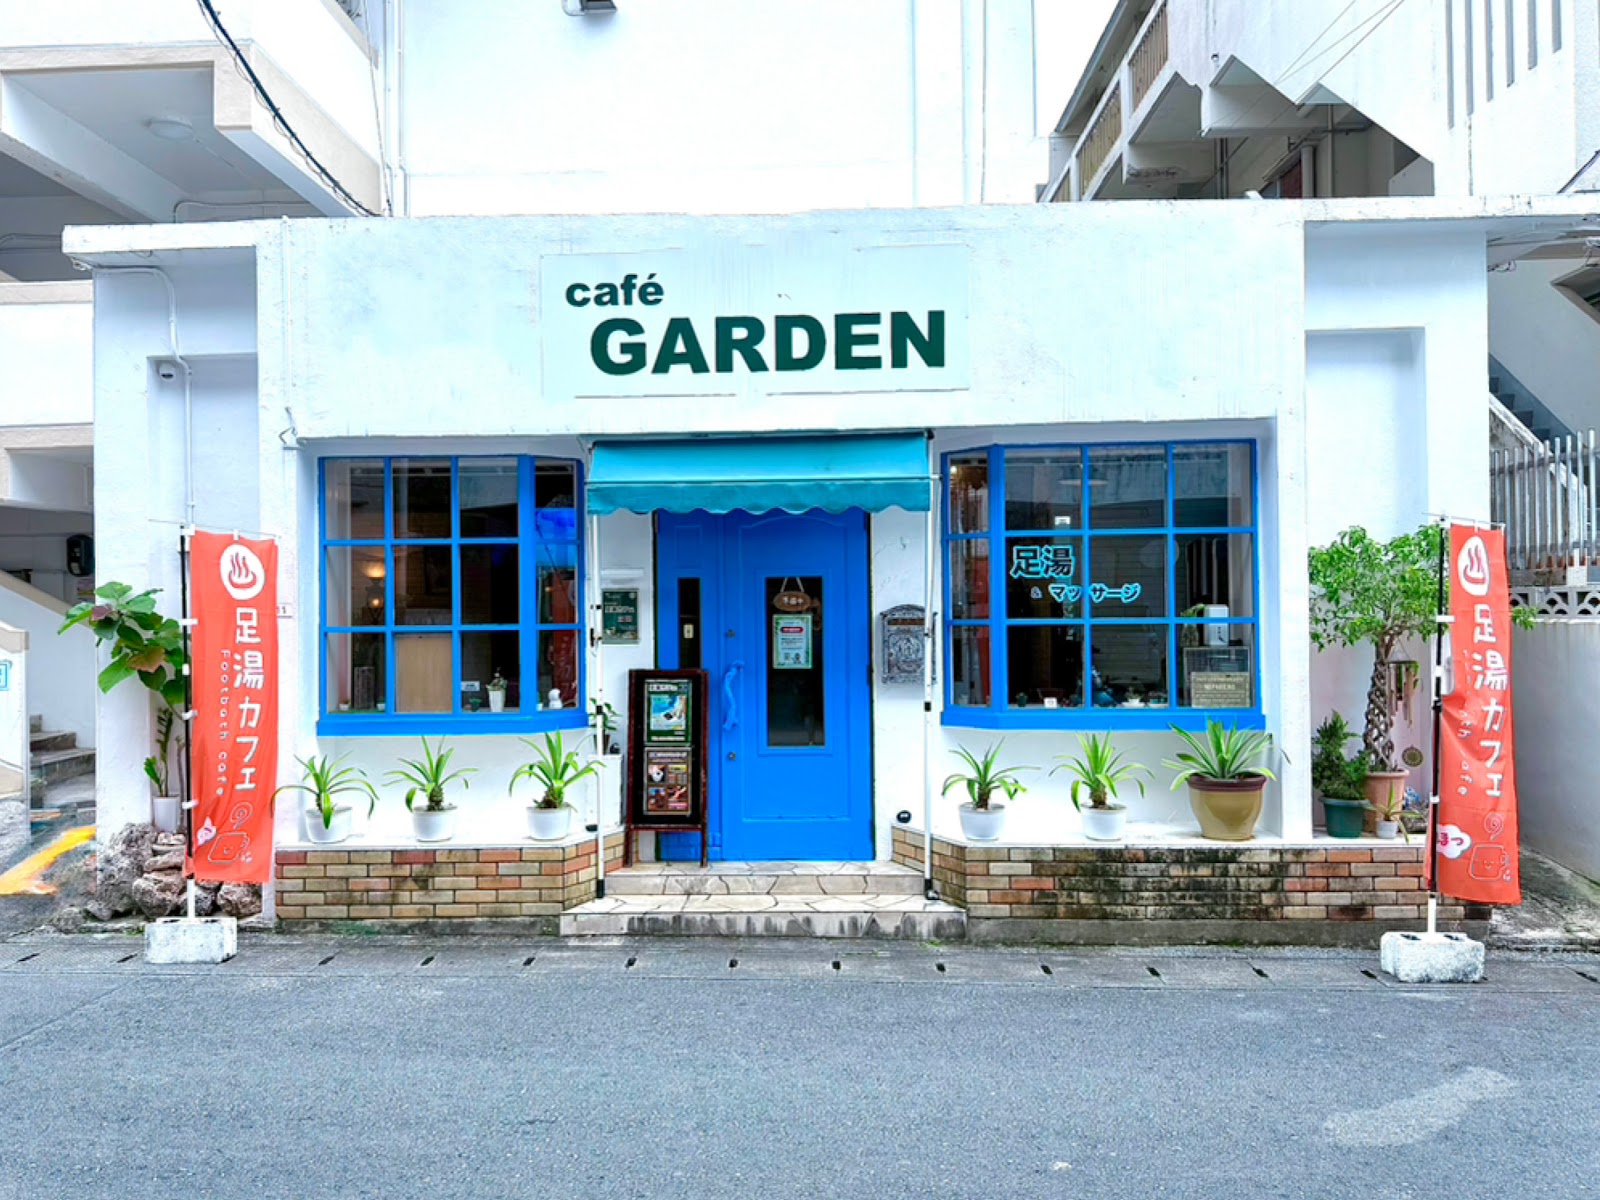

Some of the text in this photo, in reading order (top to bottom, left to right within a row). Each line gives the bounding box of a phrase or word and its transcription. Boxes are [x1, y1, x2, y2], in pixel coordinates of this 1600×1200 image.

[565, 273, 664, 307] café
[590, 310, 945, 375] GARDEN
[1010, 545, 1075, 578] 足湯
[1048, 583, 1142, 603] マッサージ
[232, 607, 265, 792] 足湯カフェ
[1472, 604, 1508, 797] 足湯カフェ
[216, 751, 228, 797] cafe
